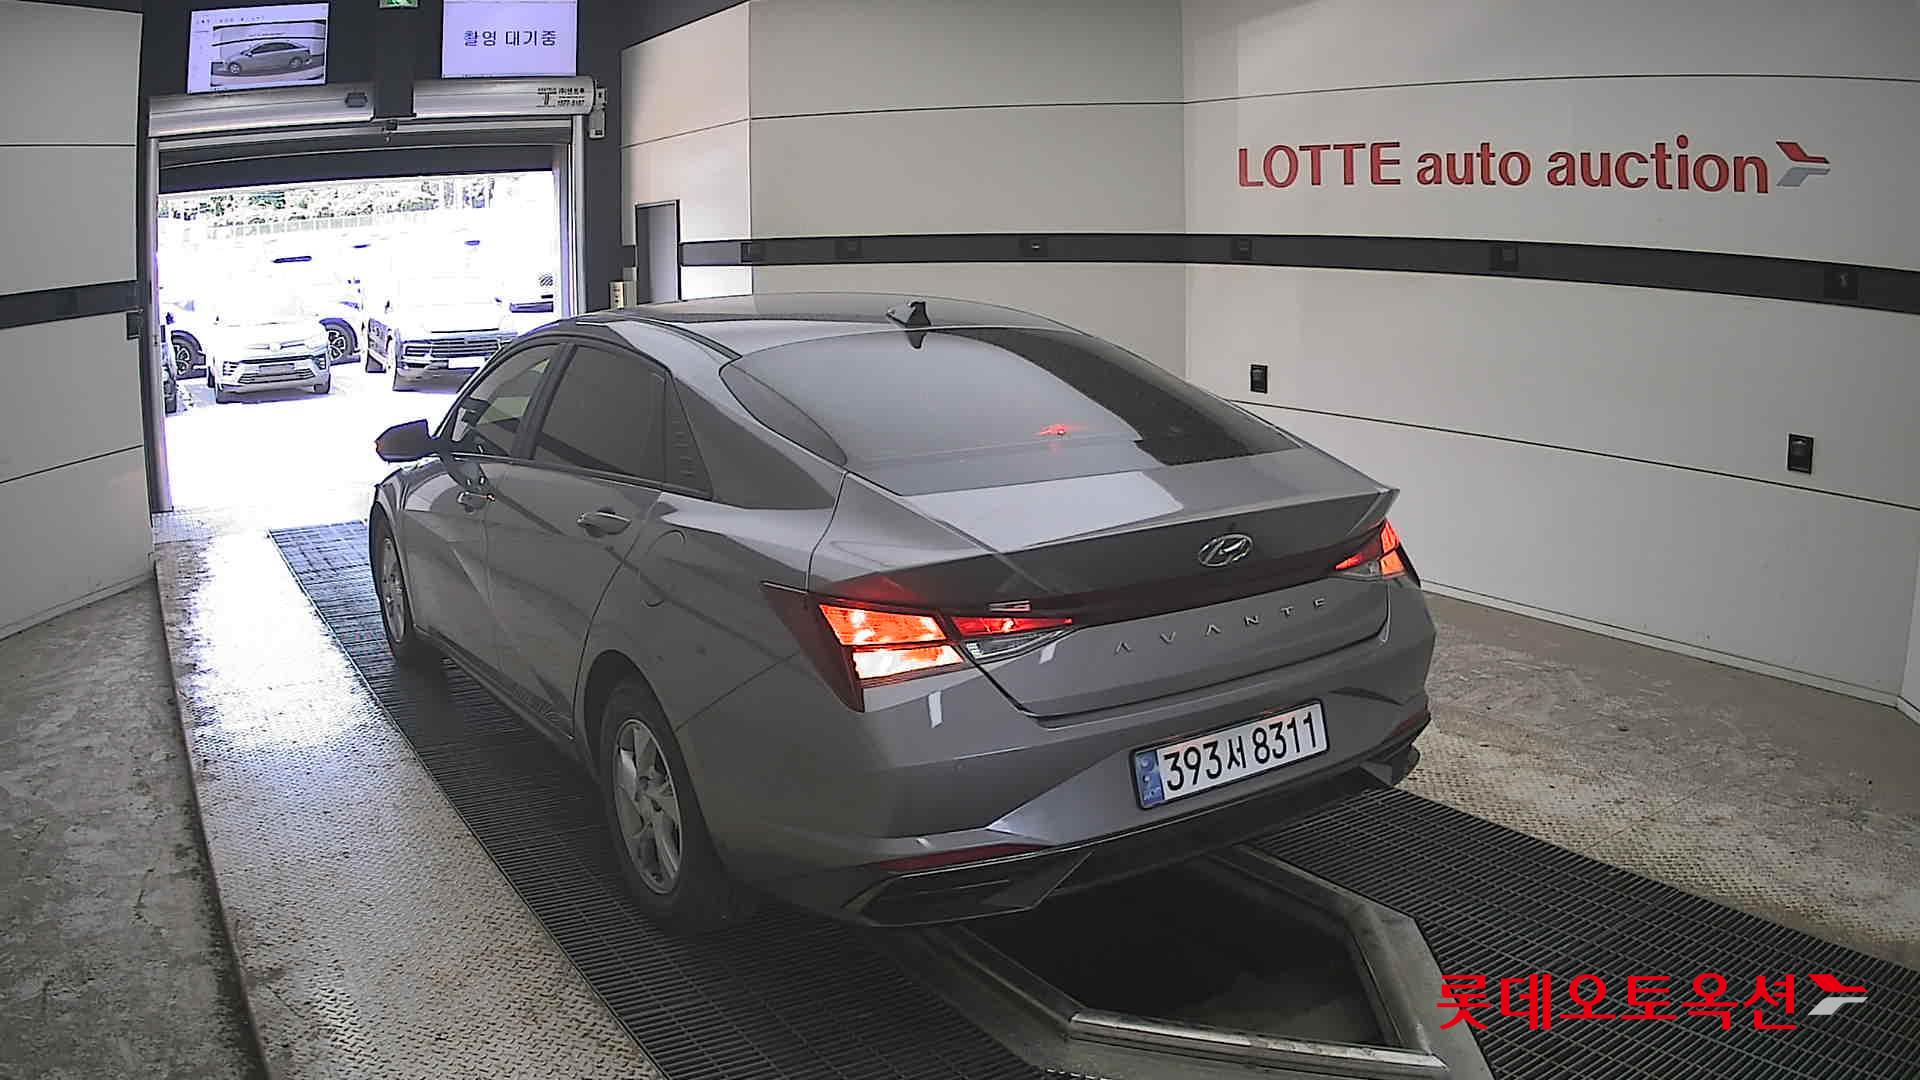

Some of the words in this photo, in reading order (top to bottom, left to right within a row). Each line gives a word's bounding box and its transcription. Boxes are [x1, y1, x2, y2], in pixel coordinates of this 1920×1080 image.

[464, 30, 497, 47] 촬영
[505, 30, 557, 47] 대기중
[1239, 142, 1400, 188] LOTTE
[1417, 142, 1531, 187] auto
[1547, 135, 1769, 194] auction
[1115, 598, 1326, 653] AVANTE
[1163, 736, 1246, 791] 393서
[1252, 711, 1316, 764] 8311
